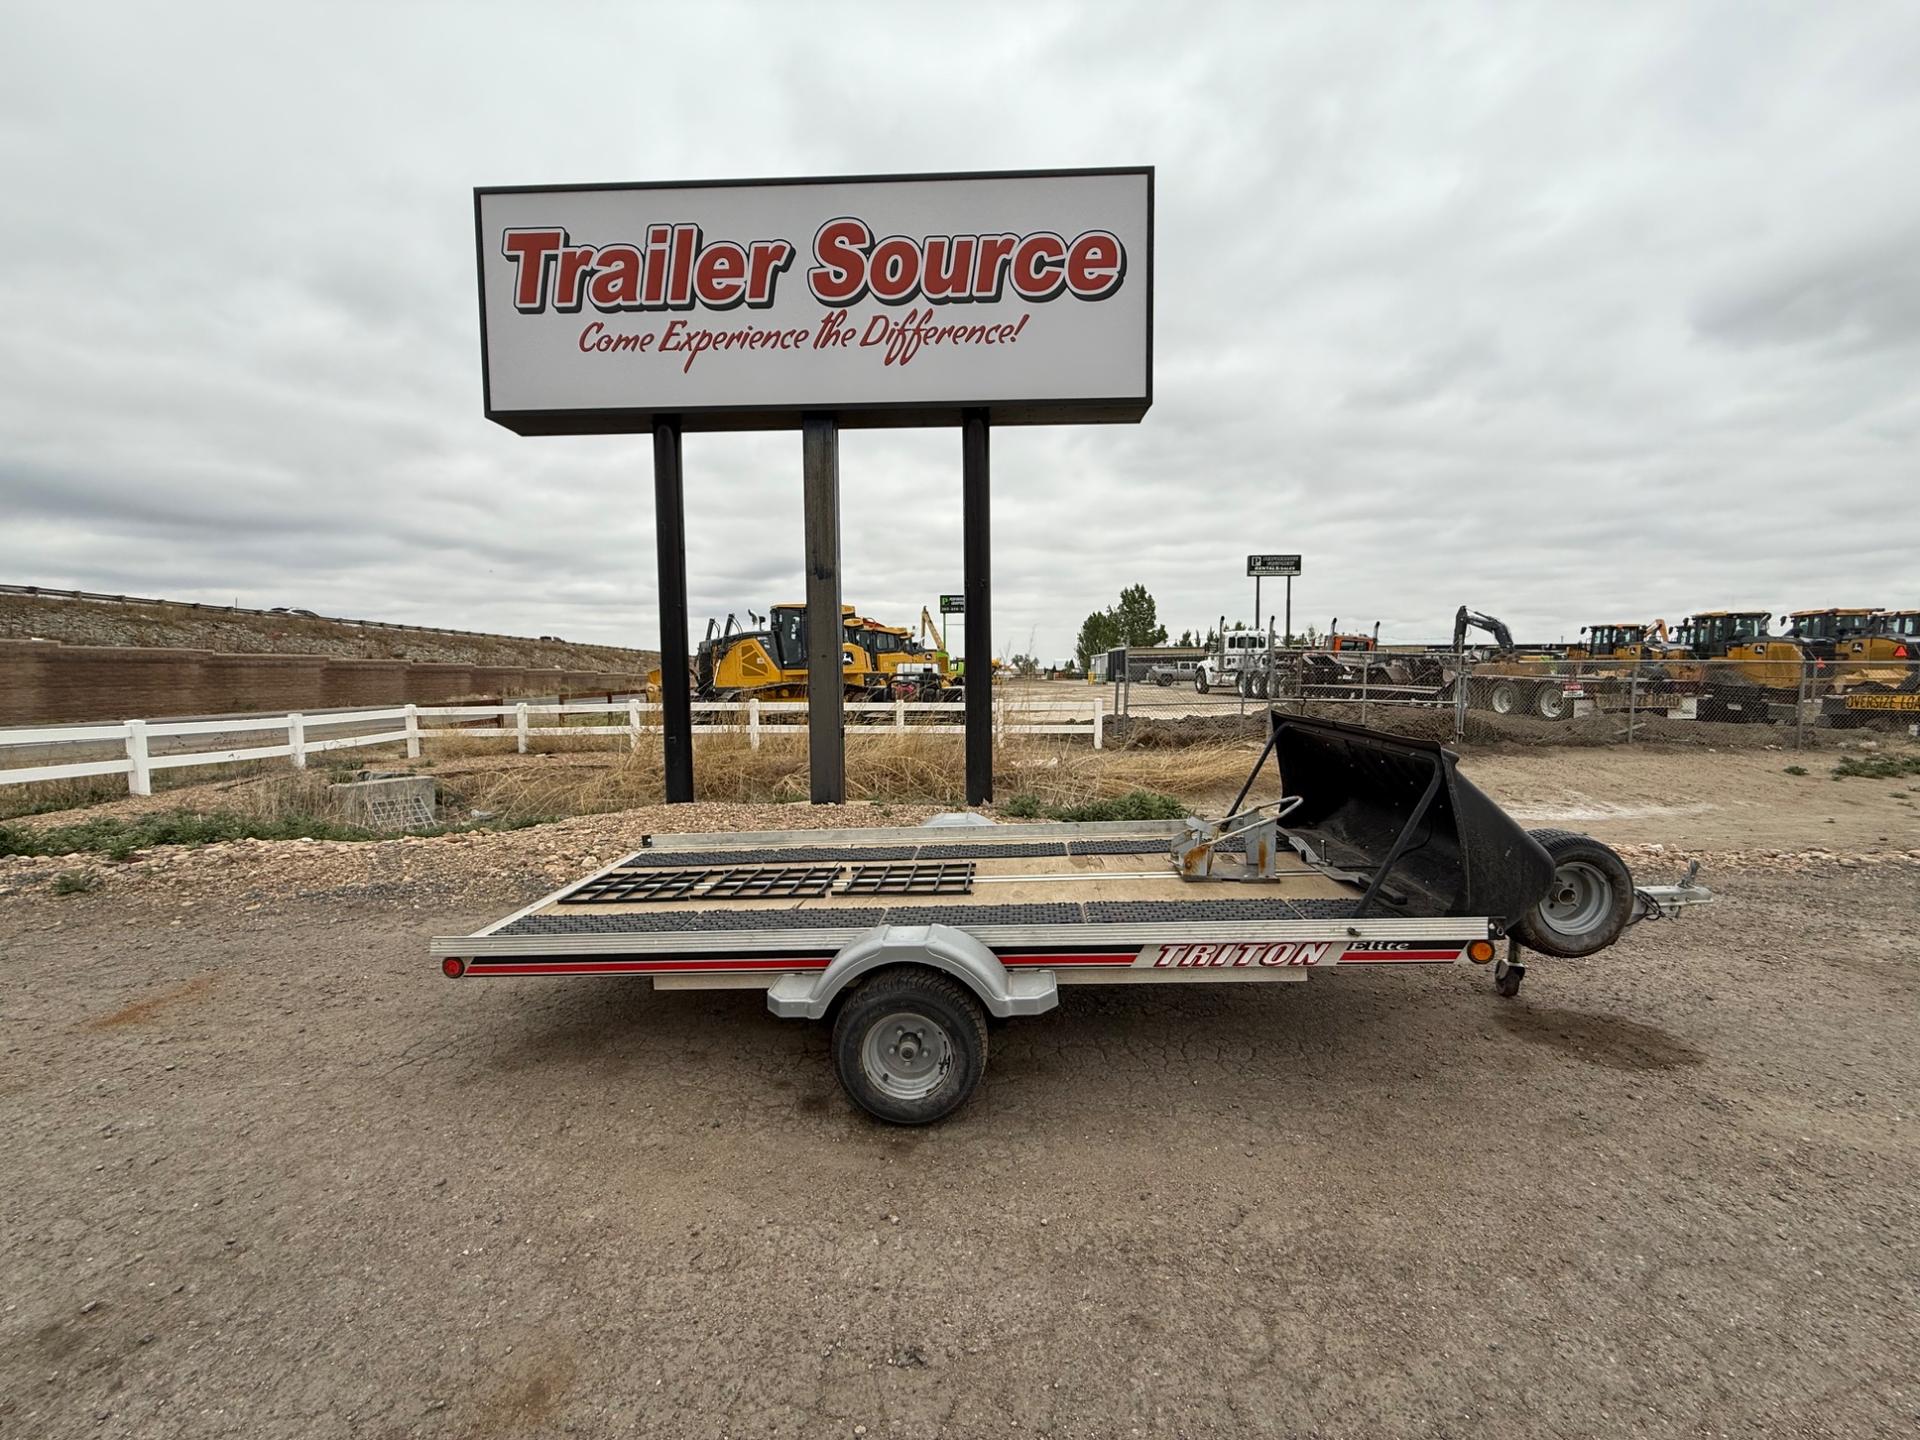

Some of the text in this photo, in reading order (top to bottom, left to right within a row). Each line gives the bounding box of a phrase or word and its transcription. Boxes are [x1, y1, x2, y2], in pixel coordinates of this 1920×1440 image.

[501, 216, 1127, 314] Trailer Source
[578, 308, 1031, 374] Come Experience the Difference!
[1846, 695, 1897, 709] OVERSIZE
[1153, 941, 1331, 968] TRITON
[1350, 940, 1410, 951] Elite
